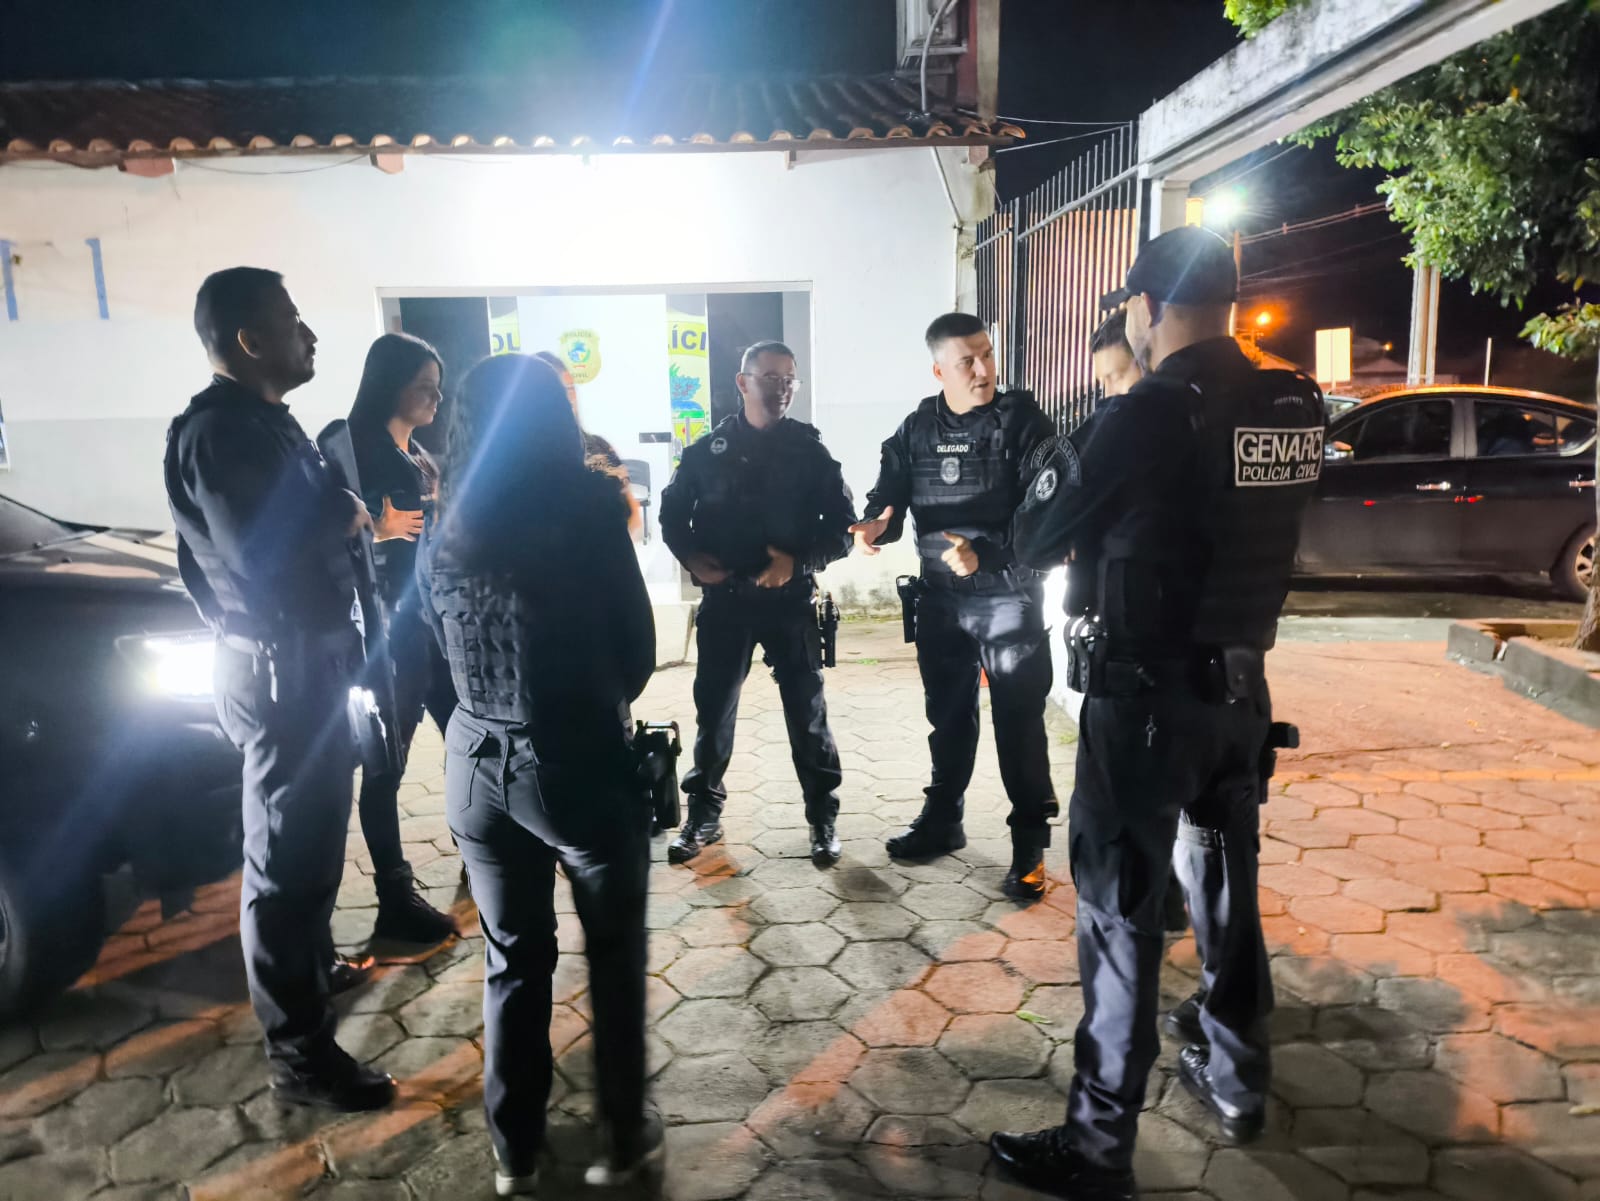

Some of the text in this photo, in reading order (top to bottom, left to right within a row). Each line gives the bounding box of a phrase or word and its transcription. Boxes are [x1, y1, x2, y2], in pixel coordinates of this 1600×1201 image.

[936, 444, 969, 453] DELEGADO
[1239, 432, 1320, 463] GENARC
[1242, 463, 1317, 481] POLÍCIA CIVIL
